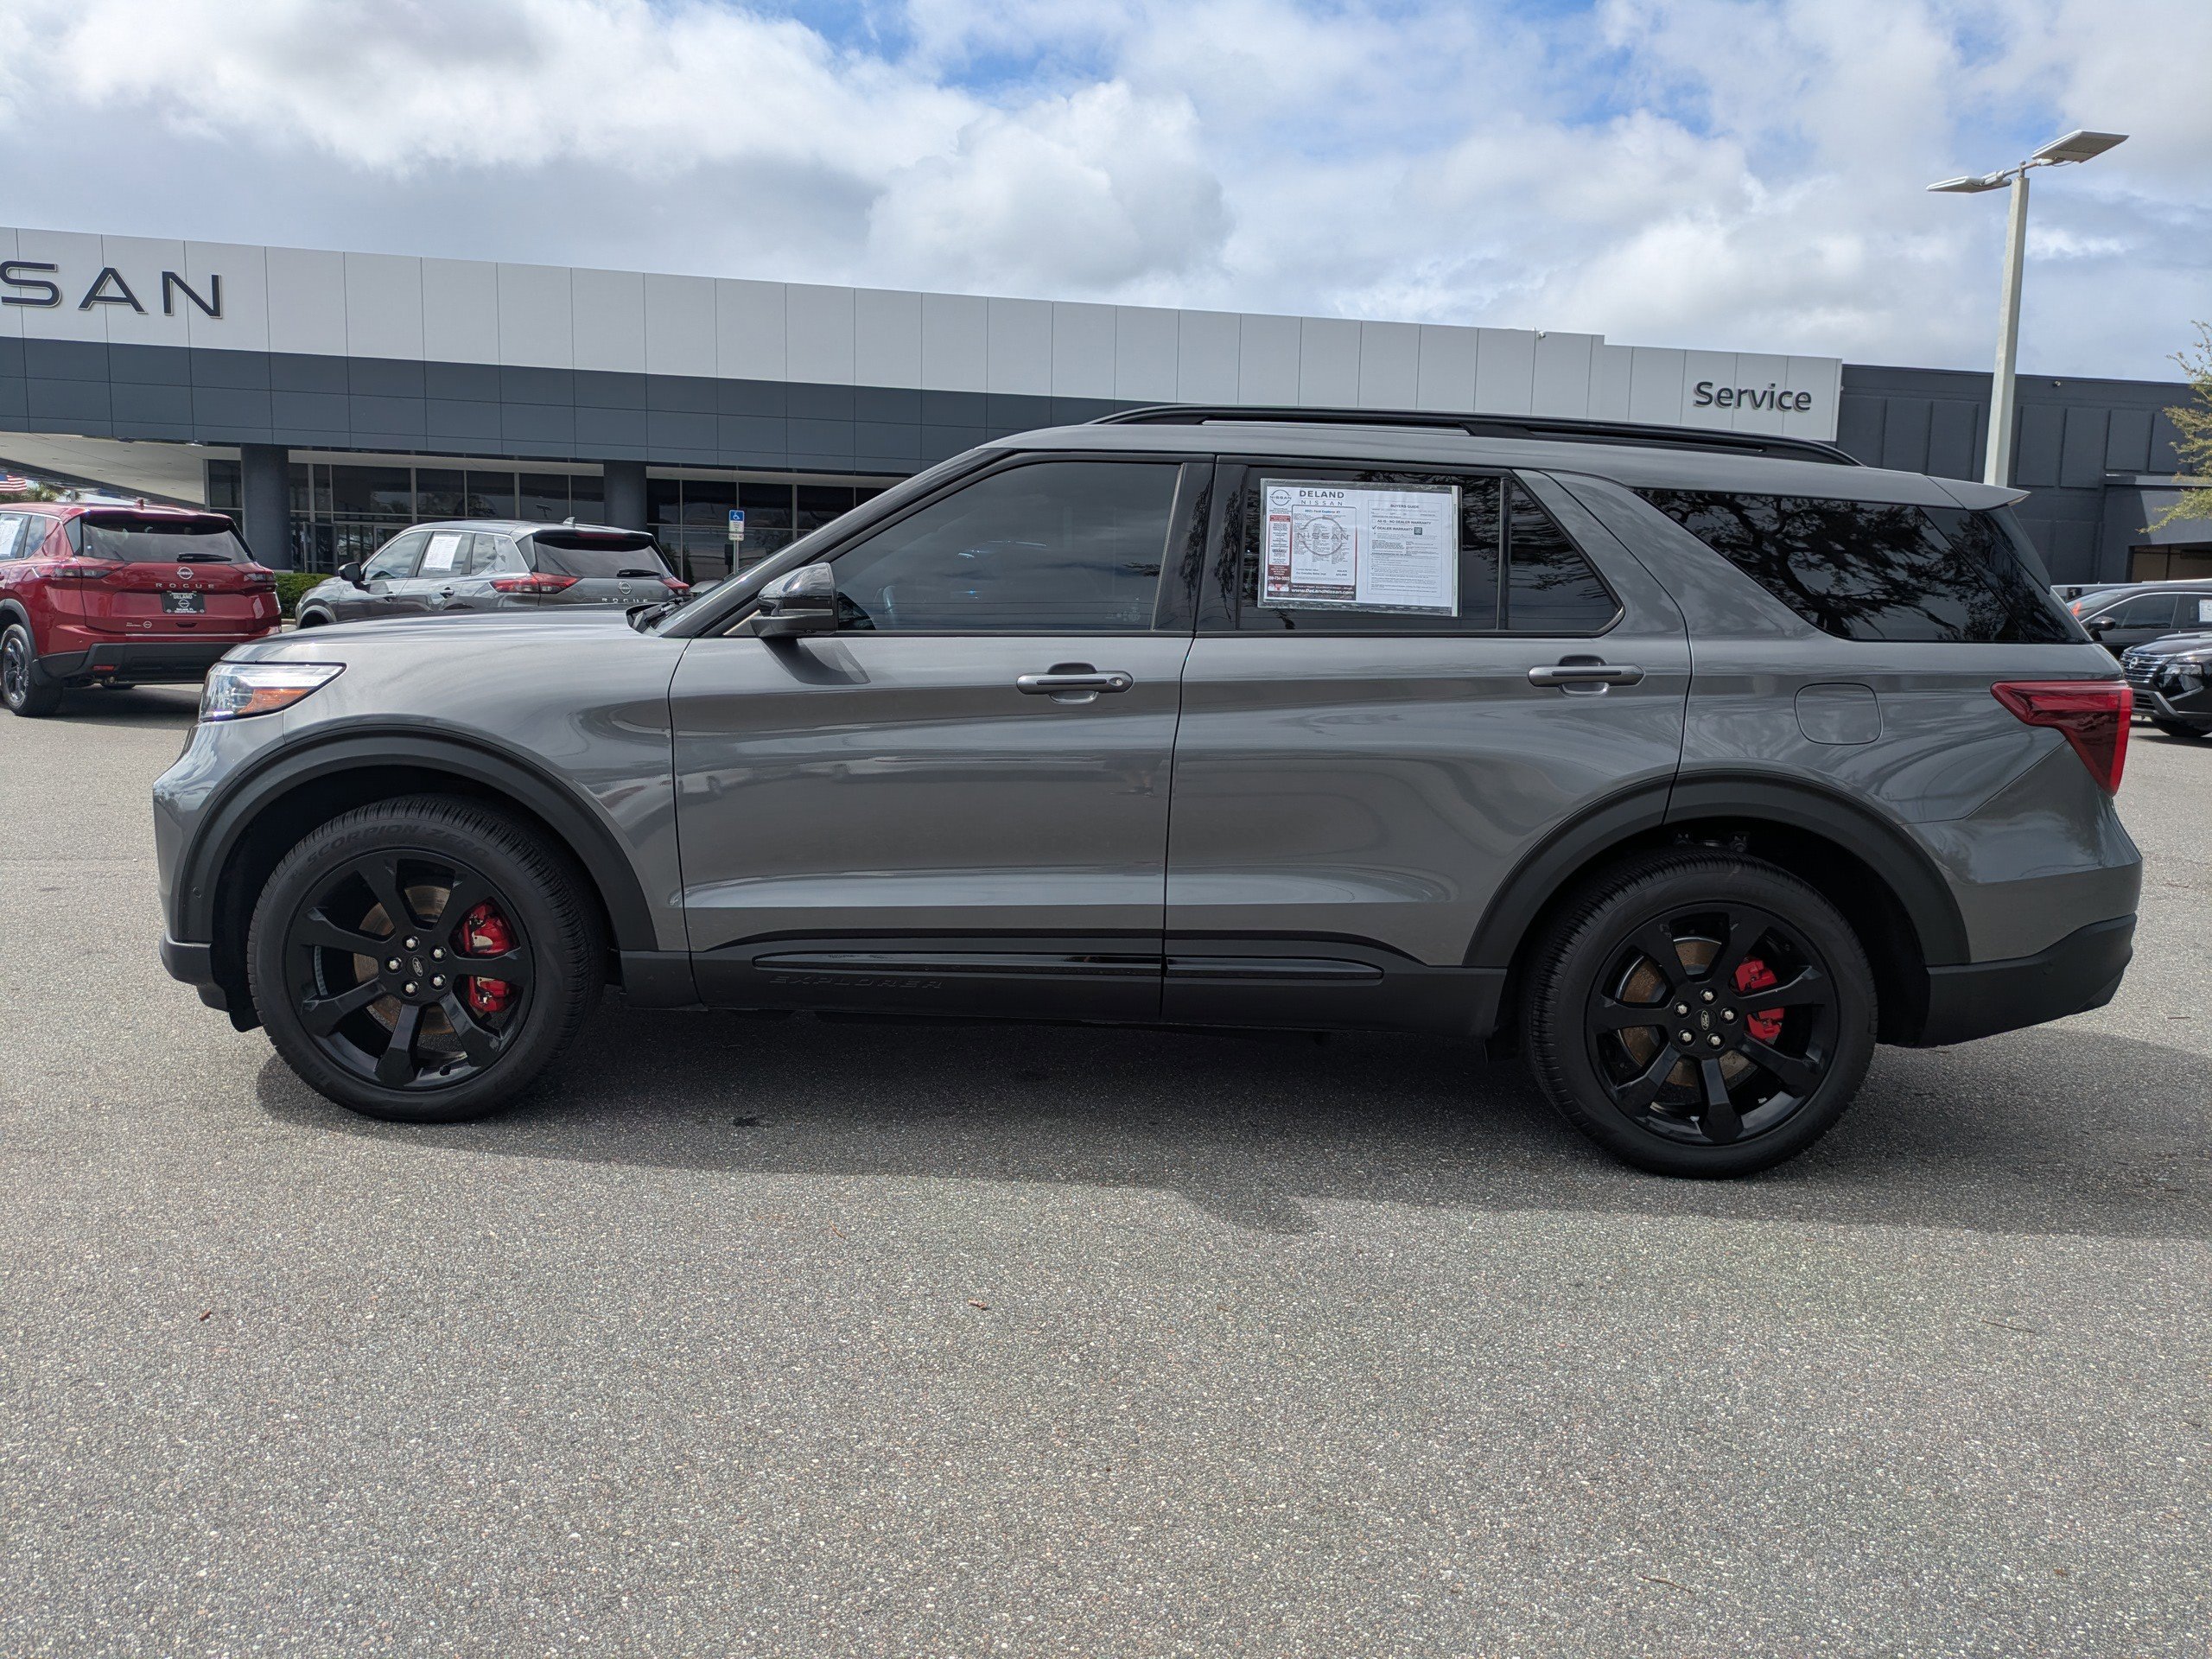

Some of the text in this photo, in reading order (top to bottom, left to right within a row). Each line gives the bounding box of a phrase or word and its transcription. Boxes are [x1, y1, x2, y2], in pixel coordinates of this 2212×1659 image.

[0, 261, 222, 319] SAN
[1694, 381, 1812, 412] Service
[1299, 490, 1344, 499] DELAND
[769, 976, 944, 988] EXPLORER
